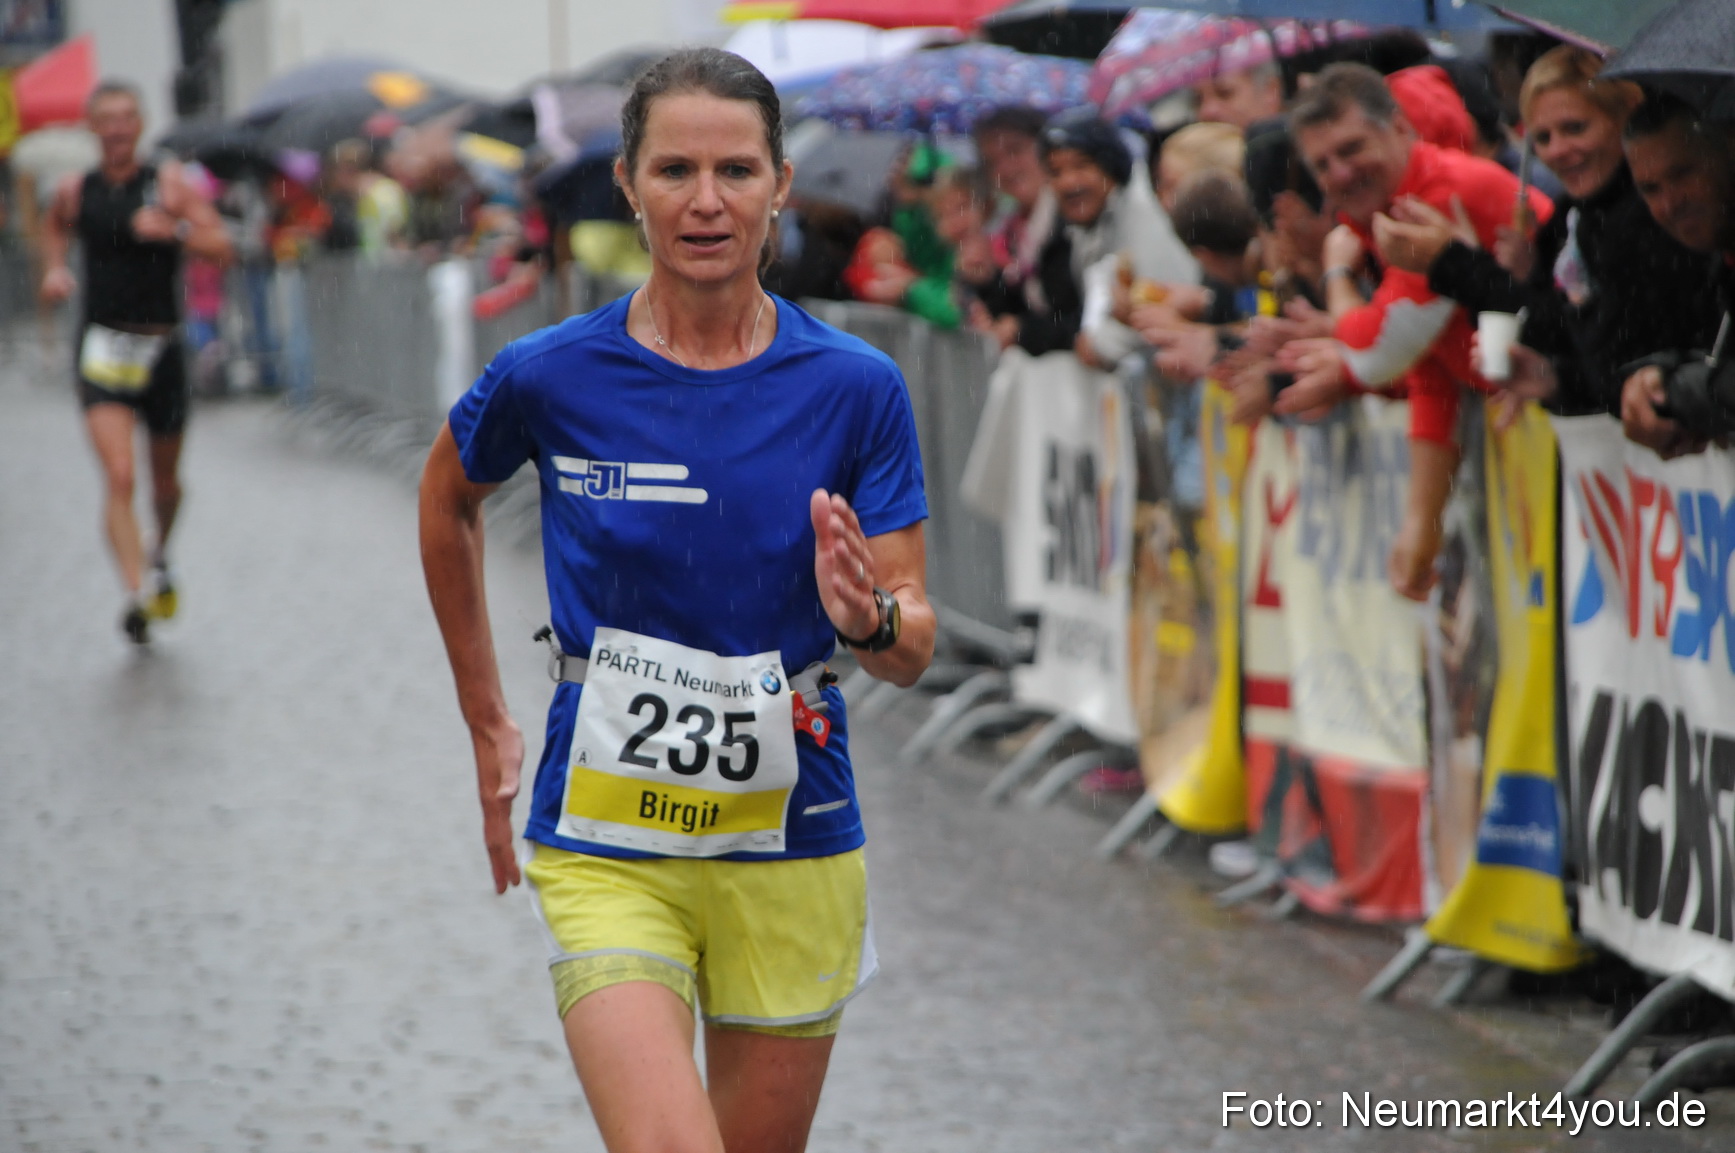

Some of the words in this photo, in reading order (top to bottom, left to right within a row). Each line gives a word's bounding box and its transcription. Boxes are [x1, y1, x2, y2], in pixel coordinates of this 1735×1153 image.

[596, 648, 667, 683] PARTL
[674, 667, 755, 698] Neumarkt
[618, 692, 760, 782] 235
[638, 790, 720, 833] Birgit
